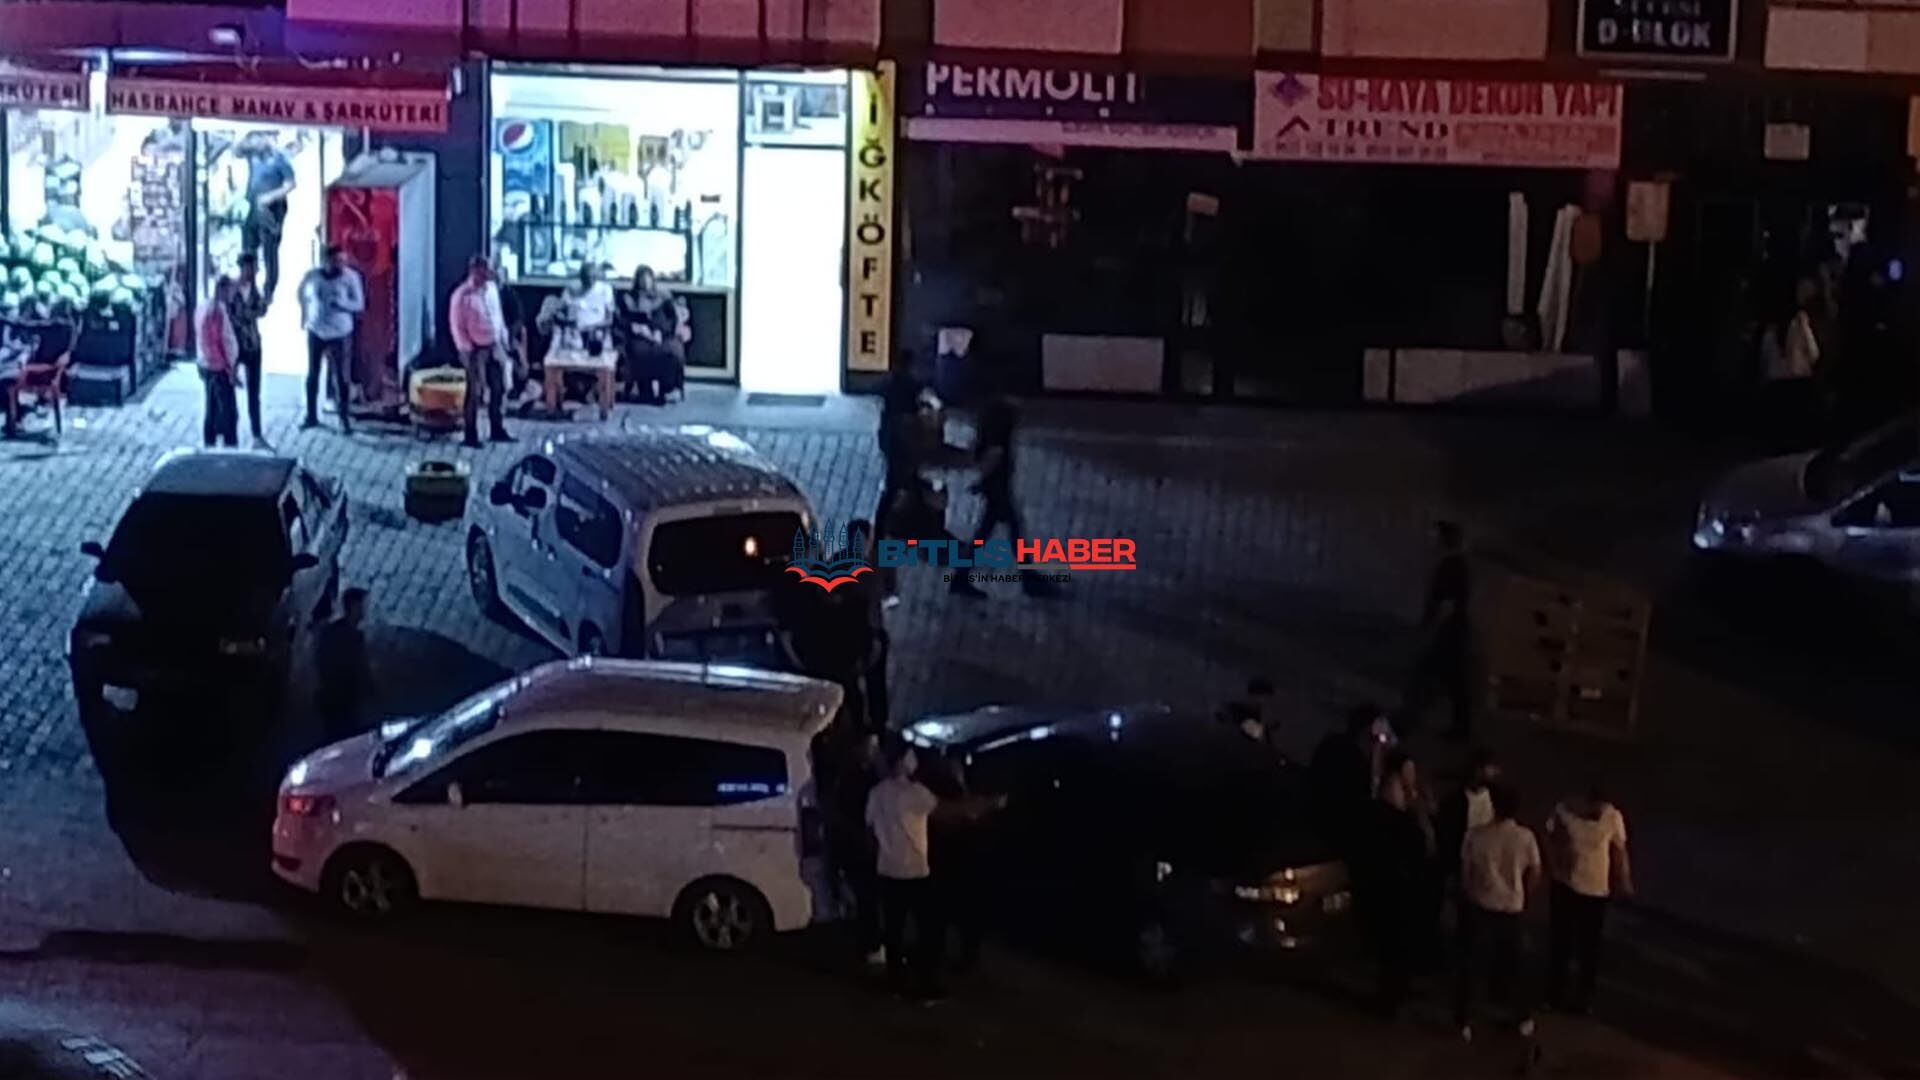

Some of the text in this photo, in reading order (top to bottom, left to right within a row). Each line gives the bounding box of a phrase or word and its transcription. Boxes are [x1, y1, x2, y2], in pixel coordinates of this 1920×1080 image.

[232, 99, 296, 119] MANAV
[304, 102, 317, 119] &
[857, 70, 886, 354] İĞKÖFTE
